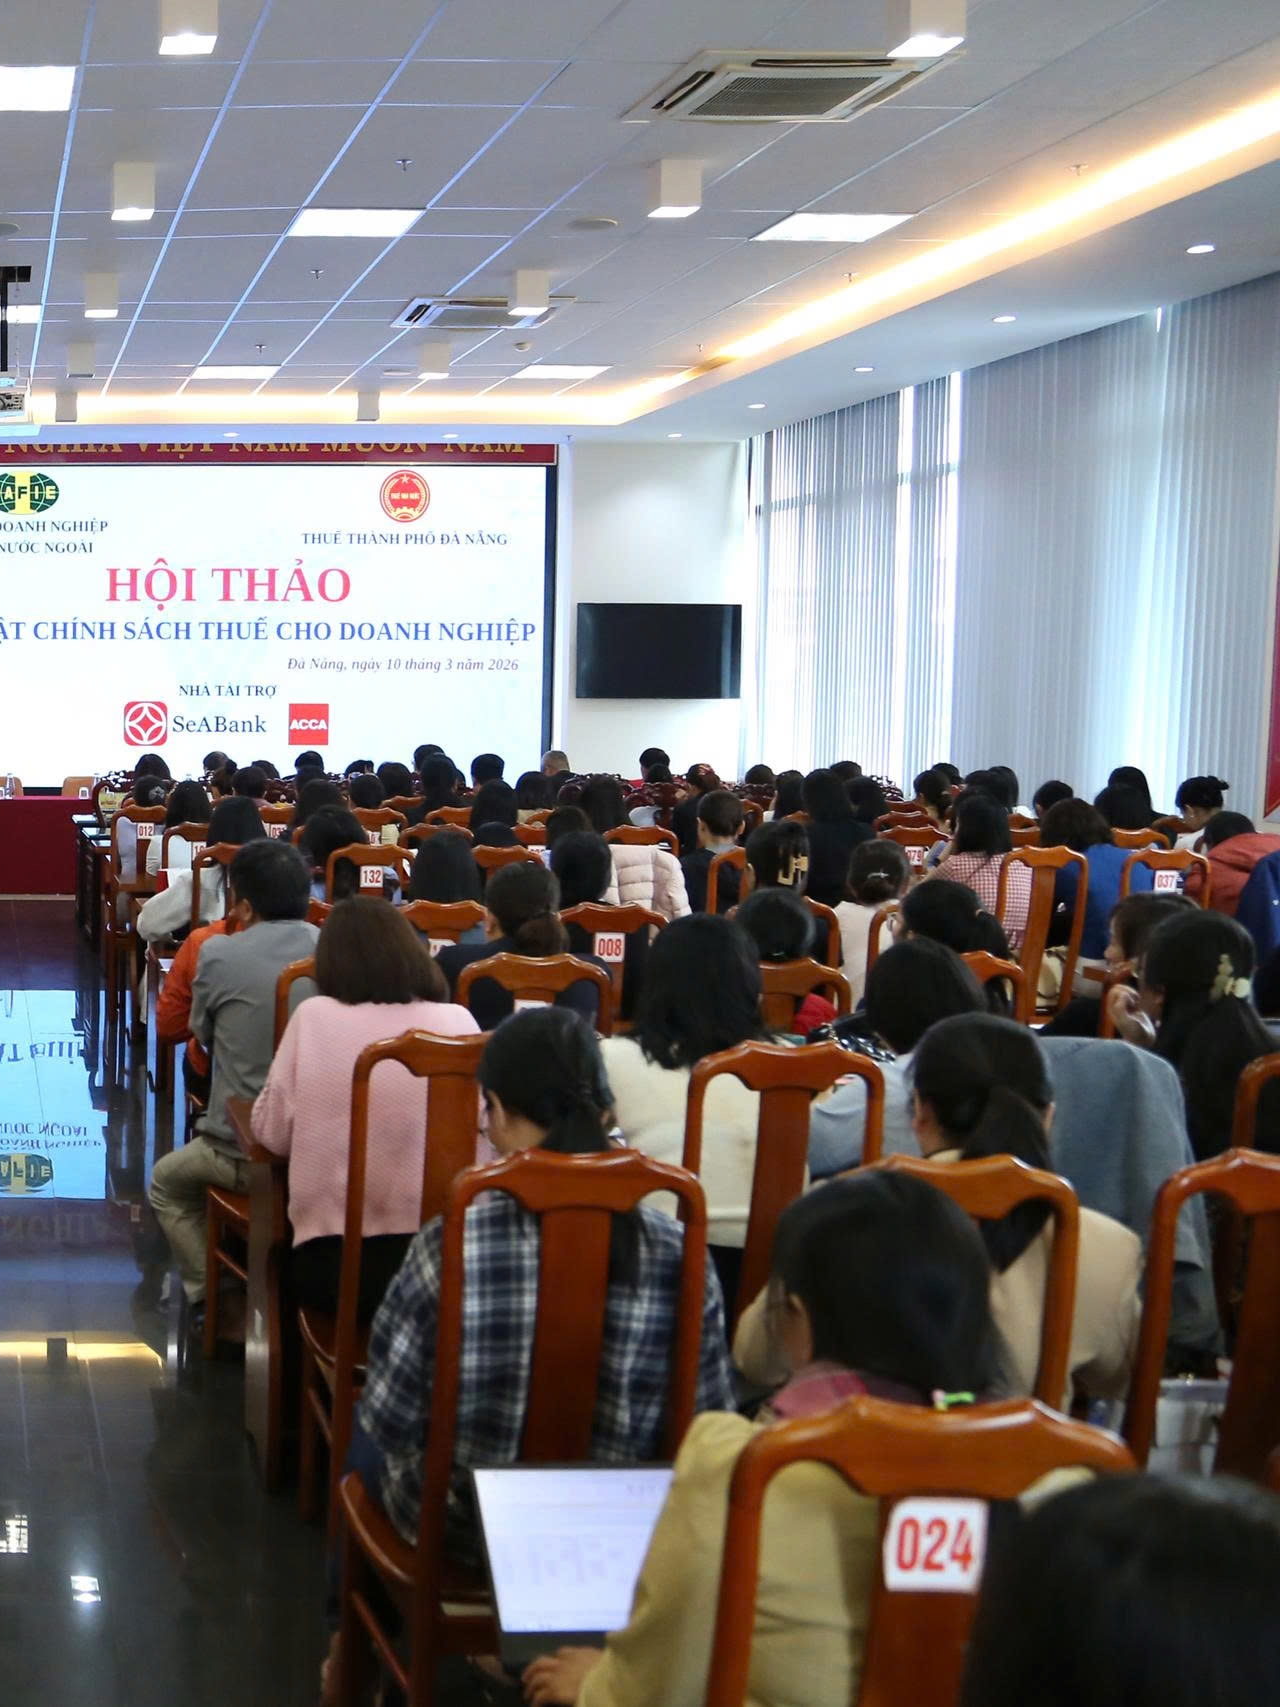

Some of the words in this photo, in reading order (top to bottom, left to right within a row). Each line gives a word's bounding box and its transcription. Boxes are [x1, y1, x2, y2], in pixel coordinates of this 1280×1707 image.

[51, 518, 108, 535] NGHIỆP
[302, 530, 342, 545] THUẾ
[348, 531, 400, 545] THÀNH
[405, 530, 435, 545] PHỐ
[441, 531, 461, 545] ĐÀ
[45, 541, 93, 554] NGOÀI
[105, 557, 197, 611] HỘI
[211, 558, 351, 603] THẢO
[33, 616, 116, 640] CHÍNH
[123, 616, 192, 640] SÁCH
[198, 616, 269, 640] THUẾ
[276, 621, 331, 641] CHO
[339, 622, 430, 641] DOANH
[439, 618, 536, 646] NGHIỆP
[387, 658, 401, 671] 10
[405, 657, 442, 674] tháng
[445, 658, 453, 671] 3
[456, 658, 484, 671] năm
[488, 658, 519, 672] 2026
[179, 683, 211, 697] NHÀ
[215, 683, 241, 697] TÀI
[244, 684, 278, 699] TRỢ
[172, 715, 267, 733] SeABank
[289, 719, 328, 731] ACCA
[139, 826, 153, 837] 012
[363, 870, 381, 883] 132
[1157, 874, 1174, 888] 037
[598, 938, 622, 957] 008
[896, 1517, 974, 1573] 024
